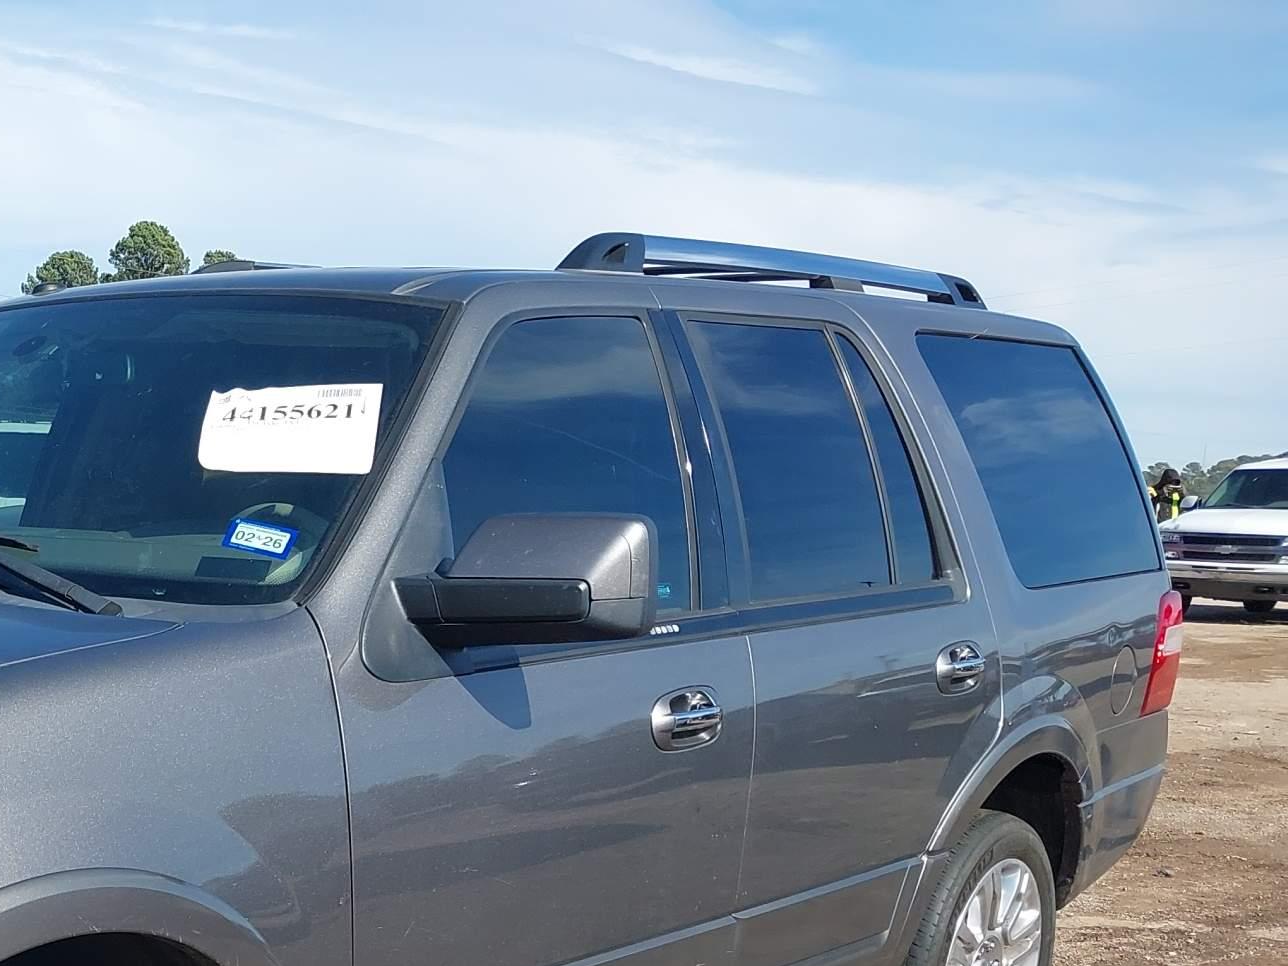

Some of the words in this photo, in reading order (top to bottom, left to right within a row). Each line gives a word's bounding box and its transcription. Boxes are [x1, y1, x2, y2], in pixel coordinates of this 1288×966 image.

[222, 403, 354, 422] 44155621
[234, 530, 256, 543] 02
[262, 536, 283, 549] 26
